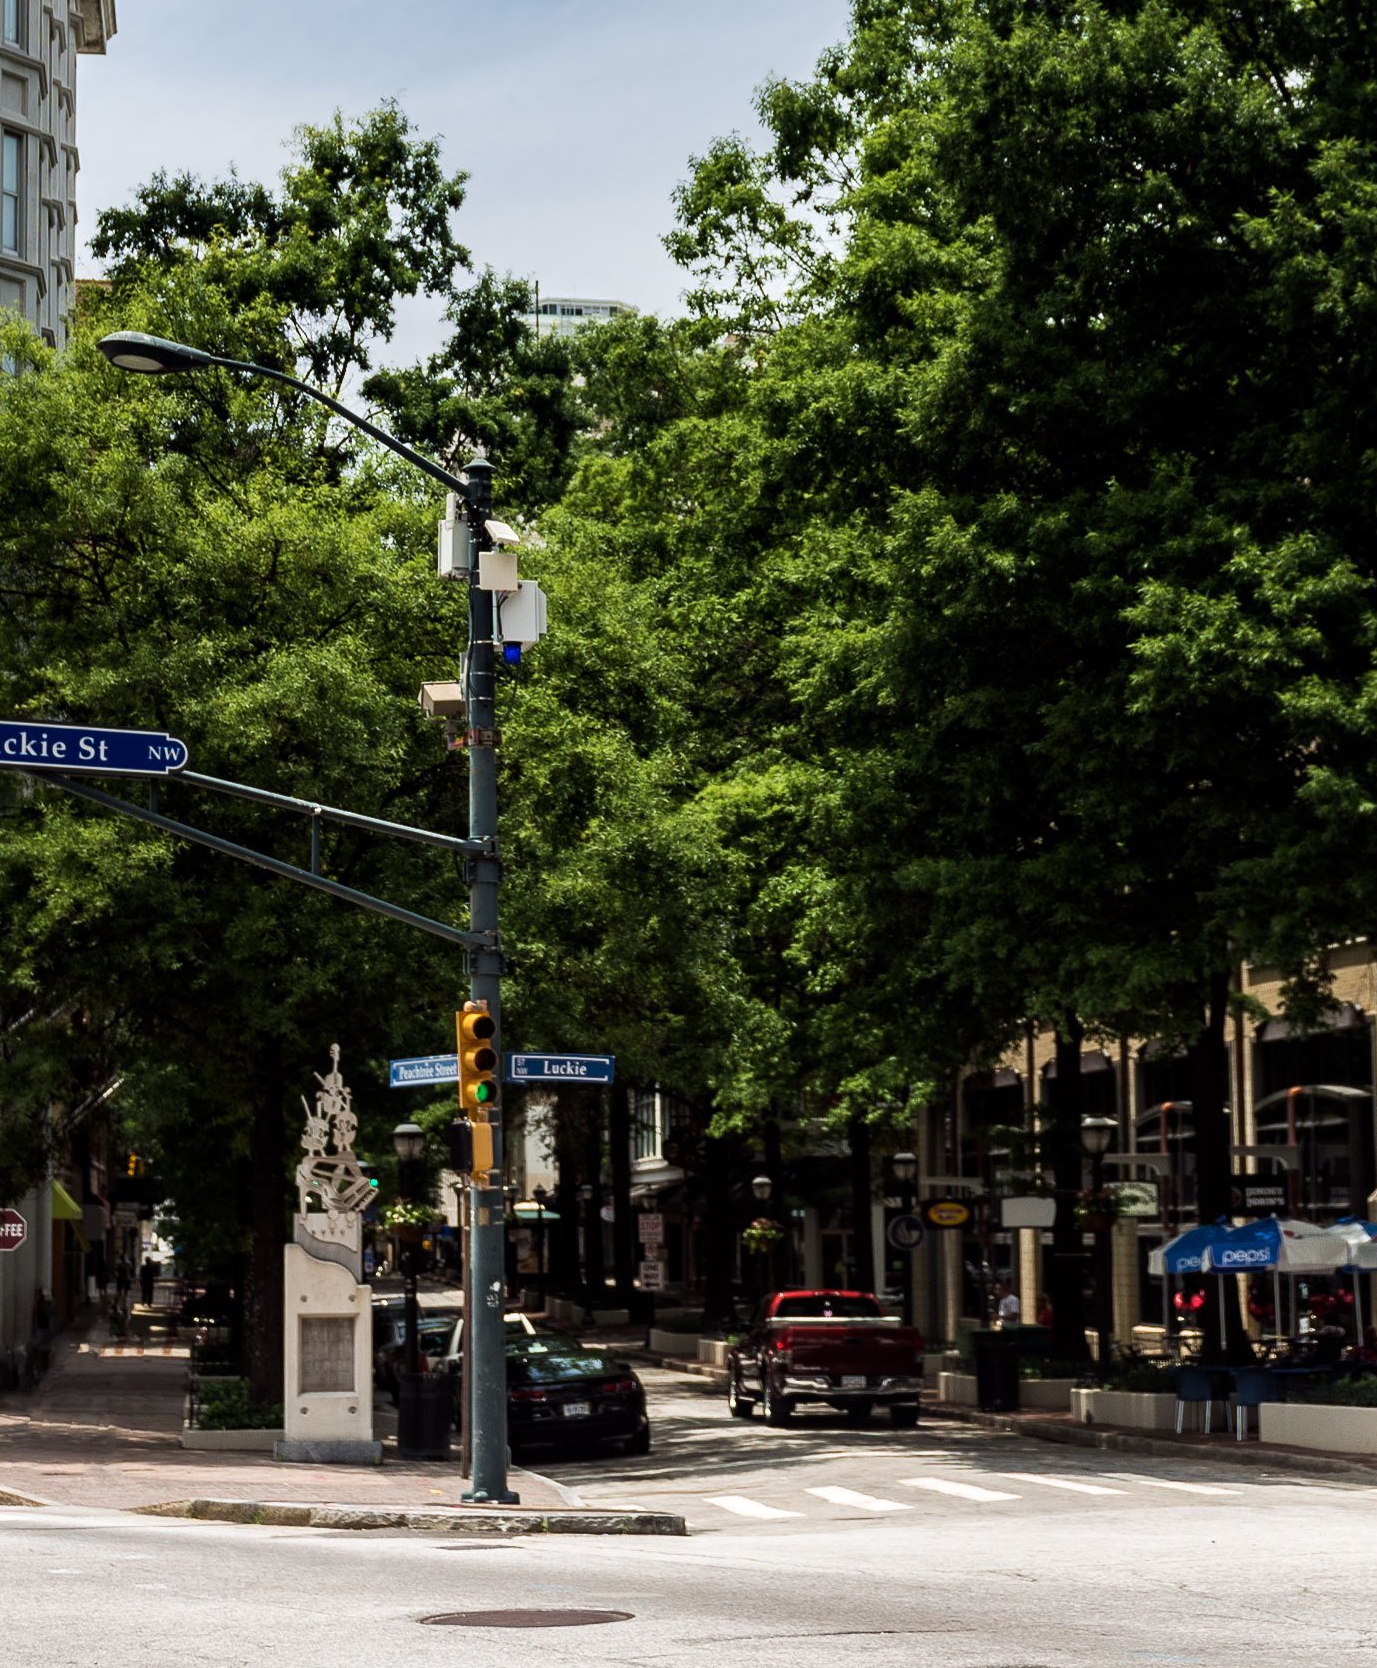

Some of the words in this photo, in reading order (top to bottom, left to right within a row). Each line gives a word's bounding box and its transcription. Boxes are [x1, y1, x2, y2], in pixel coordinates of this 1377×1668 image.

[78, 735, 109, 762] St
[148, 745, 181, 762] NW
[398, 1063, 434, 1080] Peachtree
[434, 1061, 458, 1077] Street
[543, 1060, 588, 1076] Luckie
[1222, 1247, 1271, 1264] pepsi
